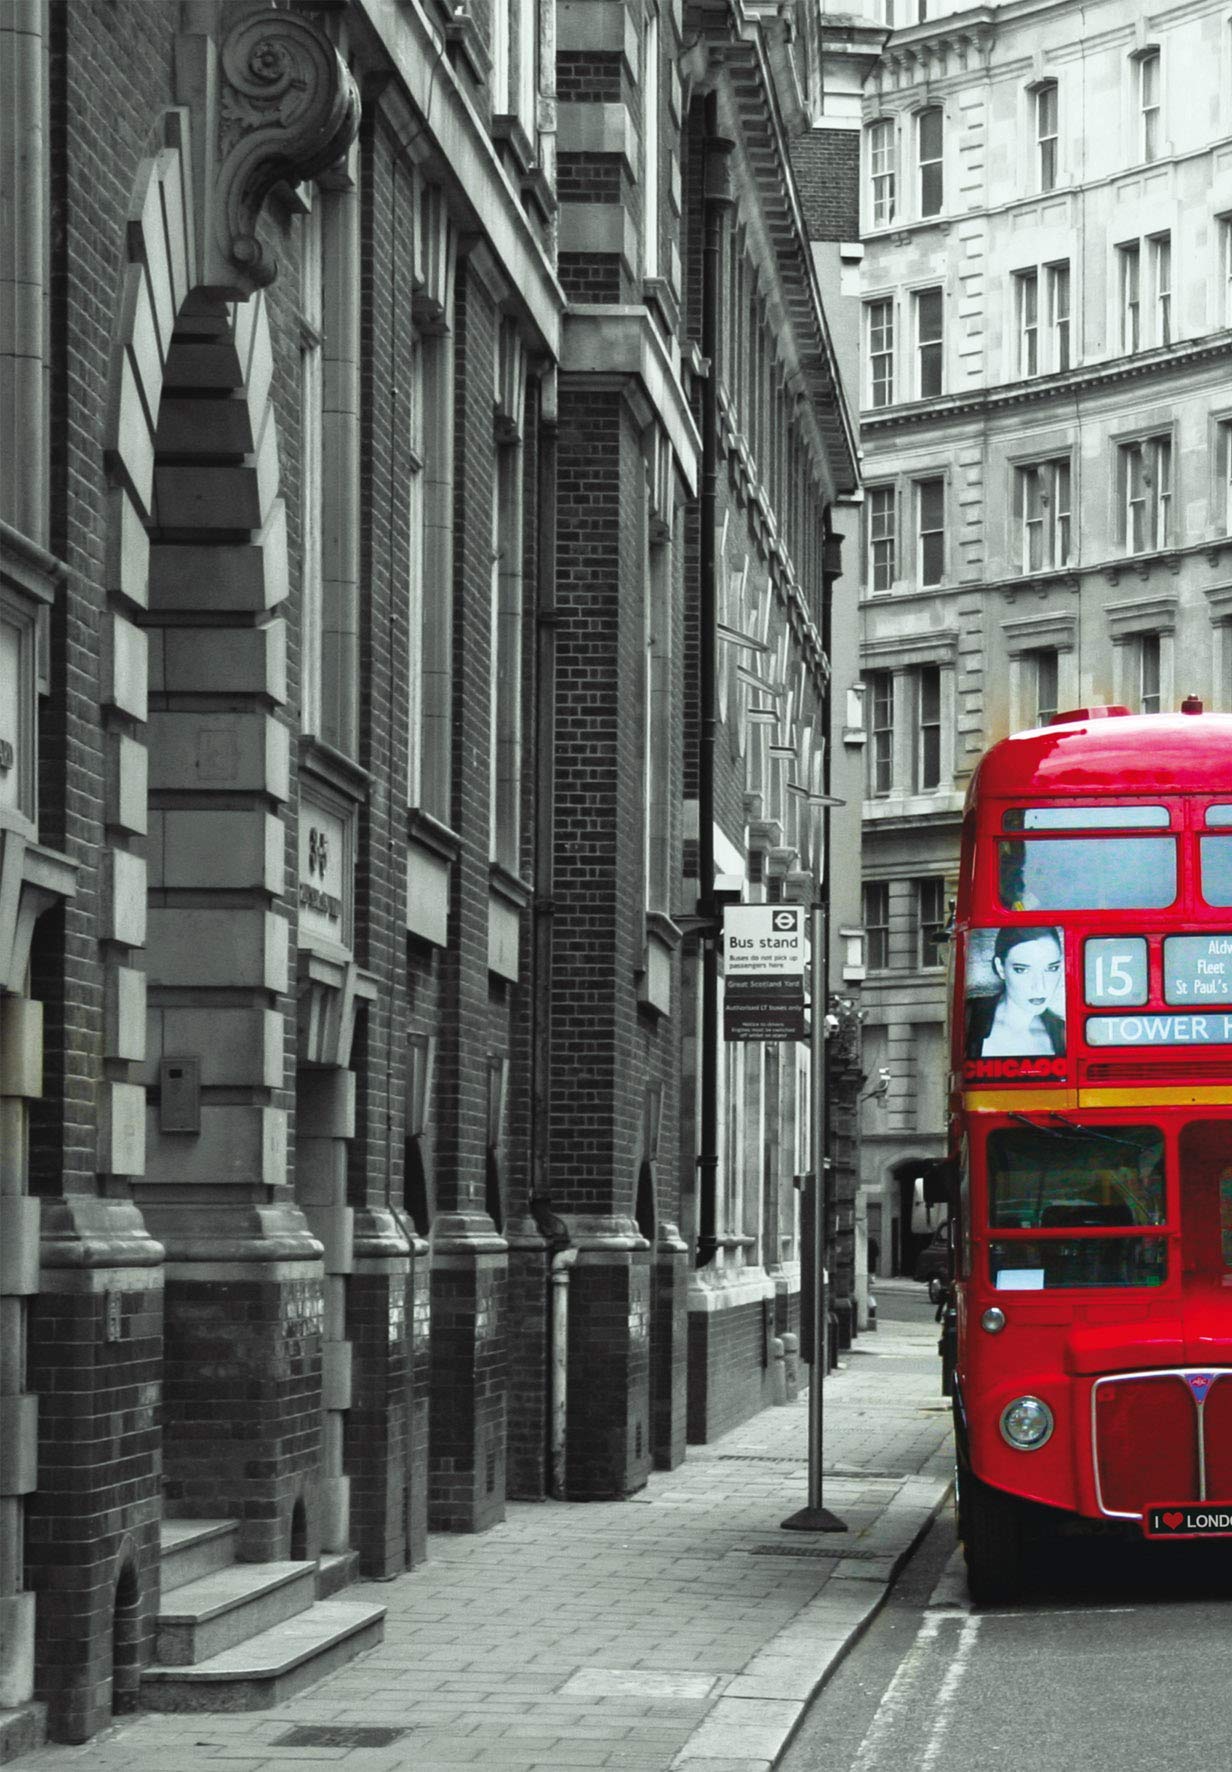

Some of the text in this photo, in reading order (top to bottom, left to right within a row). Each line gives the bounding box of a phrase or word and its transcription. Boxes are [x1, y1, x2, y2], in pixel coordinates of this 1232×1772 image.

[729, 936, 798, 948] Bus stand
[1197, 960, 1225, 975] Fleet
[1096, 956, 1133, 997] 15
[1176, 979, 1188, 995] St
[1194, 979, 1228, 994] Paul's
[1102, 1017, 1209, 1041] TOWER
[962, 1058, 1067, 1079] CHICAGO
[1154, 1515, 1159, 1529] I
